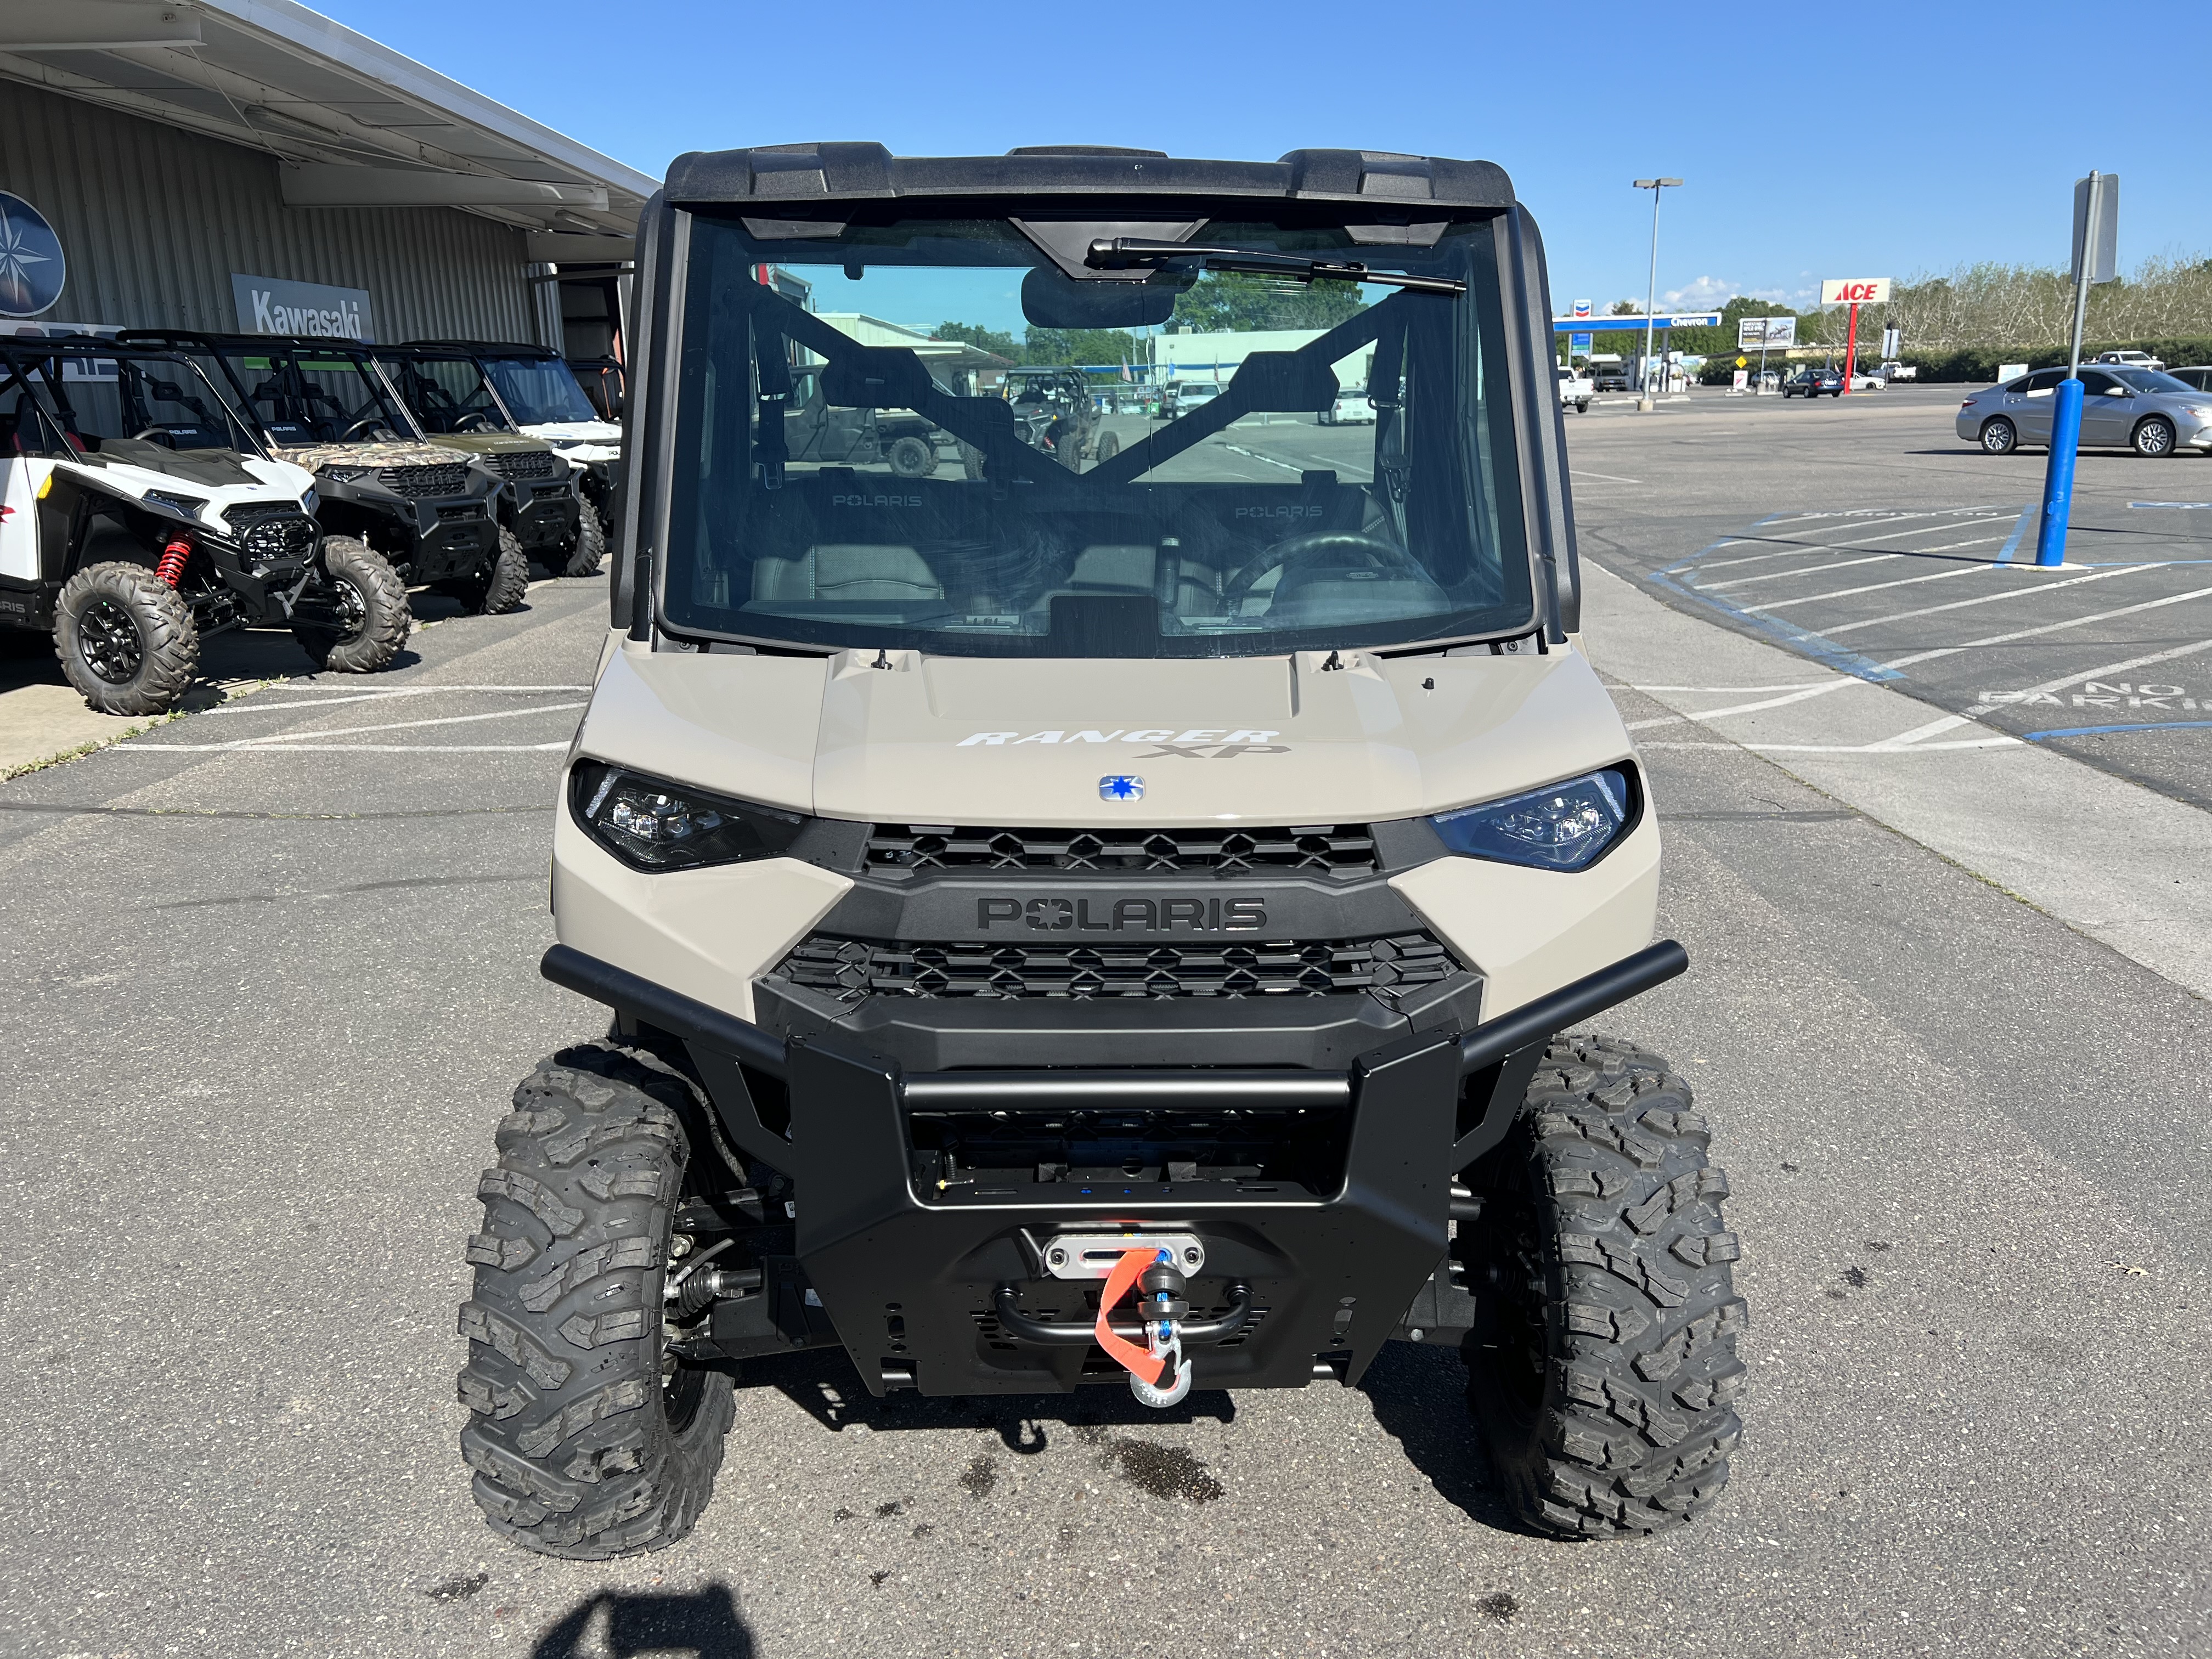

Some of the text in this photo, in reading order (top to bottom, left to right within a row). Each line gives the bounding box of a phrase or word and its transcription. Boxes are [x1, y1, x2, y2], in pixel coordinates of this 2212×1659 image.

[1834, 281, 1877, 301] ACE
[251, 290, 362, 339] Kawasaki
[1671, 317, 1708, 326] Chevron
[833, 495, 922, 506] POLARIS
[1235, 506, 1323, 518] POLARIS
[2085, 681, 2185, 696] NO
[955, 730, 1280, 747] RANGER
[1131, 744, 1293, 758] XP
[978, 898, 1267, 930] POLARIS
